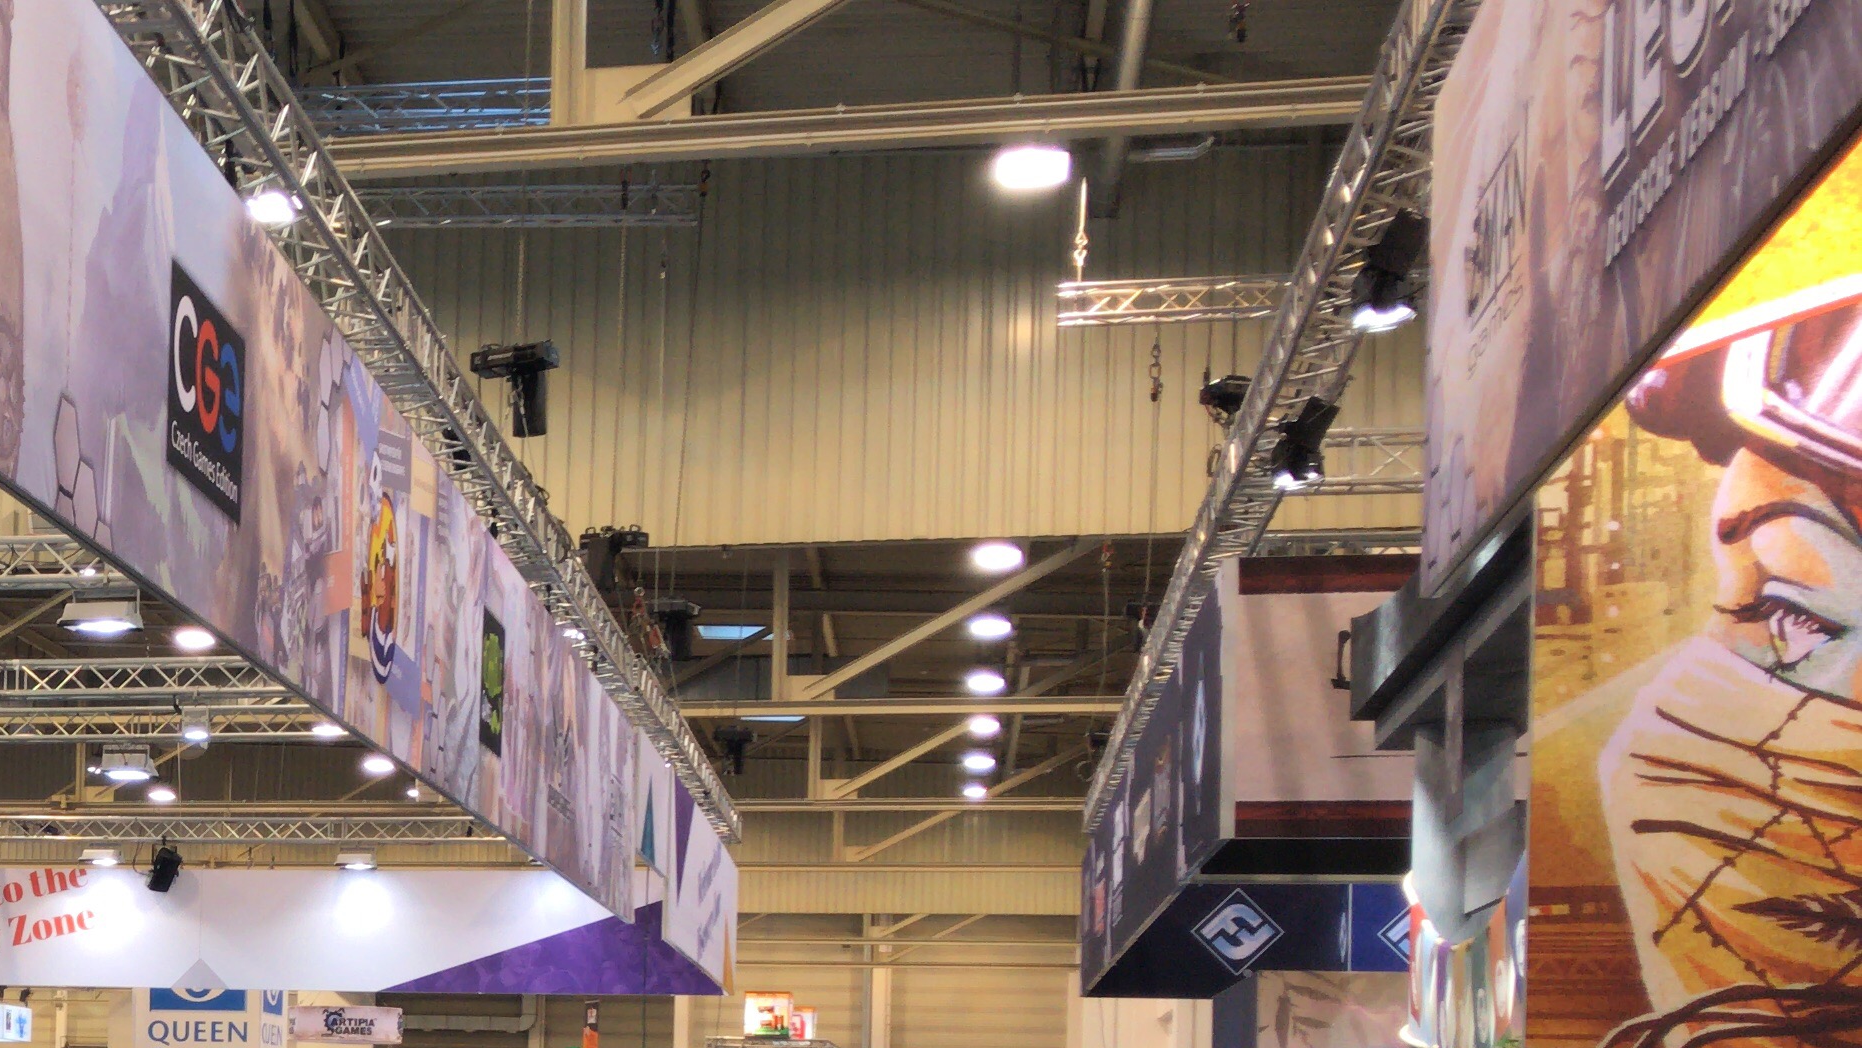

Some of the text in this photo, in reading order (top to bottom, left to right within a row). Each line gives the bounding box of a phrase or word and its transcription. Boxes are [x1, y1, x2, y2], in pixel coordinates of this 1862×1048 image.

[171, 420, 238, 503] Czech Games Edition
[29, 868, 89, 897] the
[8, 910, 95, 946] Zone
[147, 1020, 248, 1043] QUEEN
[330, 1017, 375, 1027] ARTIPIA
[335, 1027, 373, 1036] GAMES
